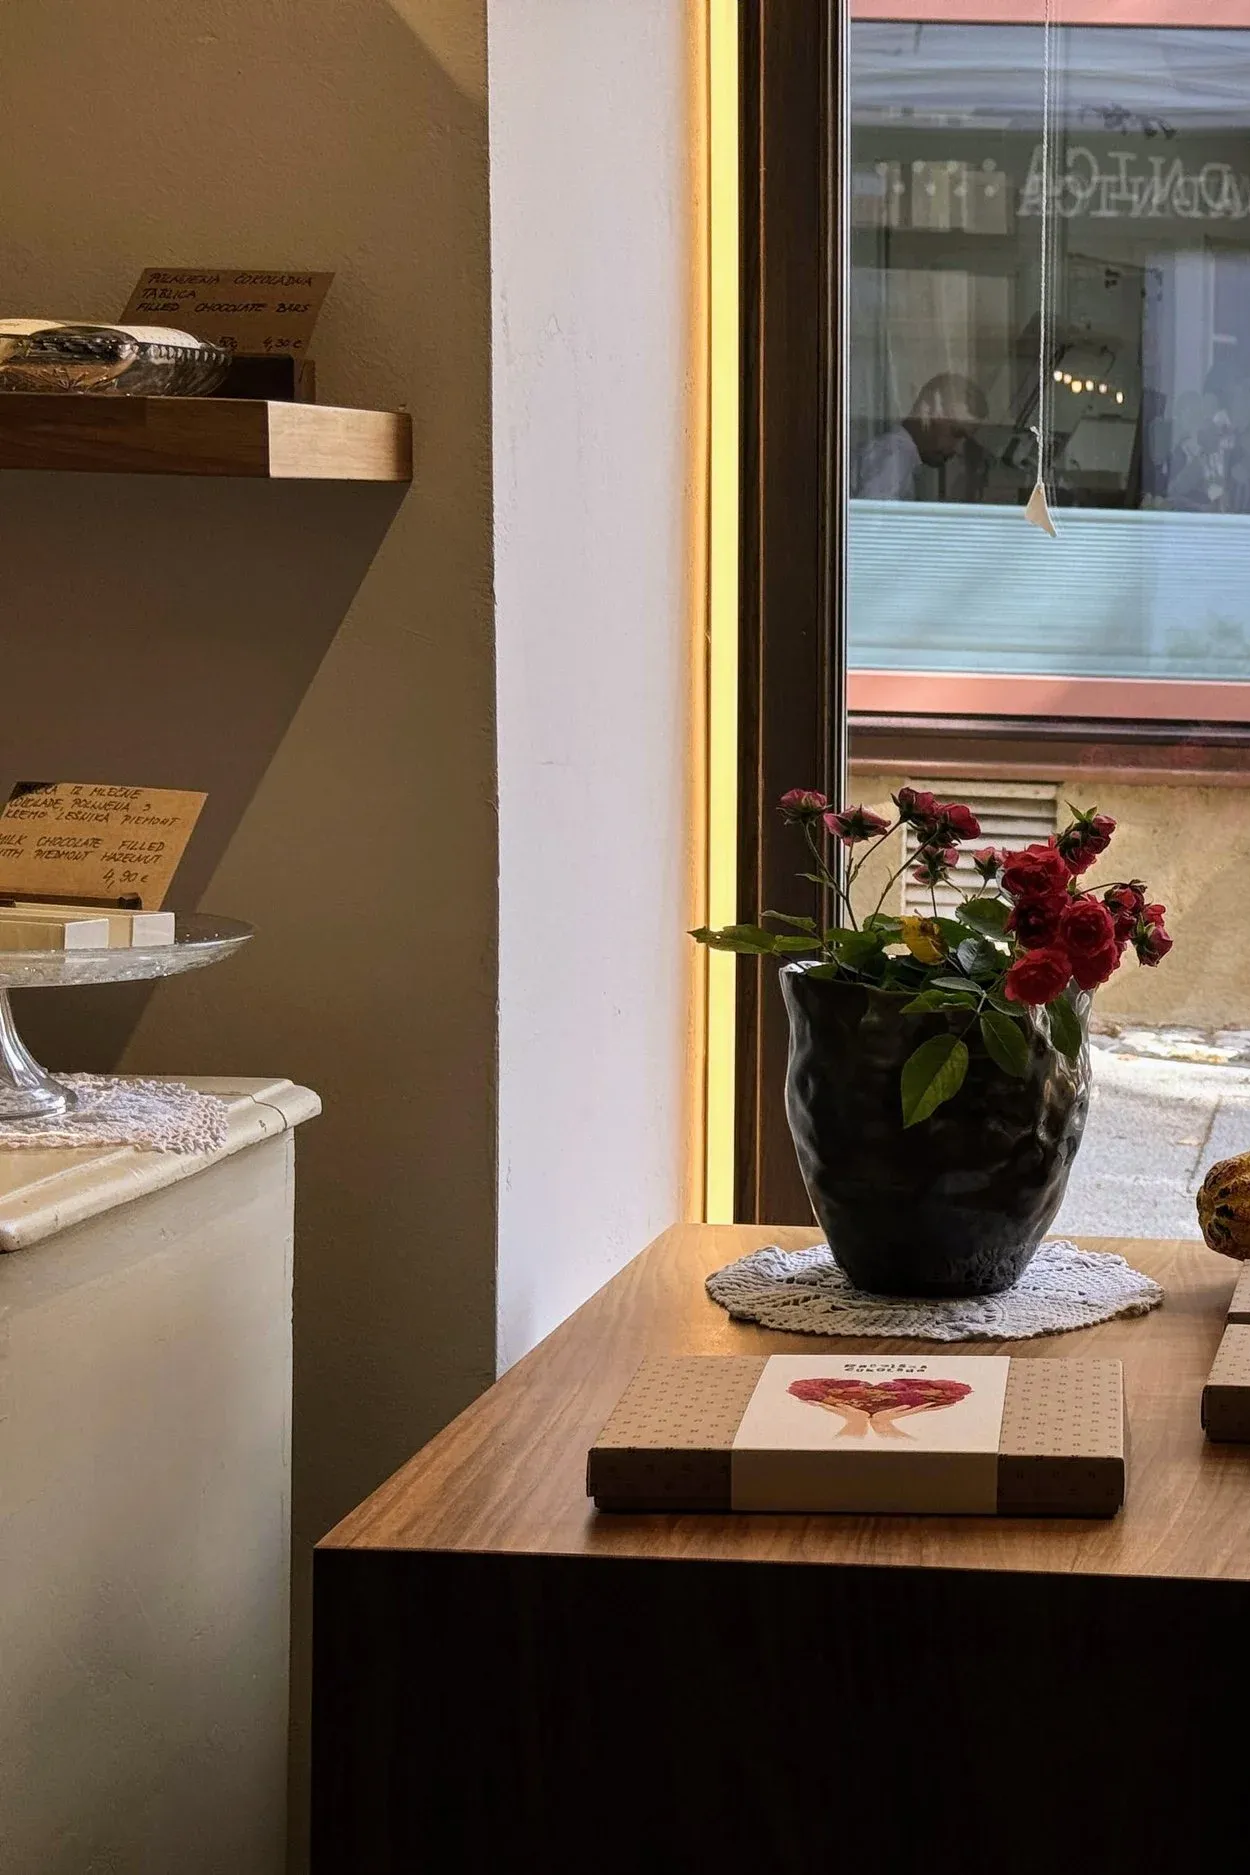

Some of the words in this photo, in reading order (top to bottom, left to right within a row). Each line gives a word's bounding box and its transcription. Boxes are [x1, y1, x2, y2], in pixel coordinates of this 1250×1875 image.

[136, 302, 179, 312] FILLED
[194, 302, 269, 313] CHOCOLATE
[36, 836, 103, 849] CHOCOLATE
[118, 840, 165, 852] FILLED
